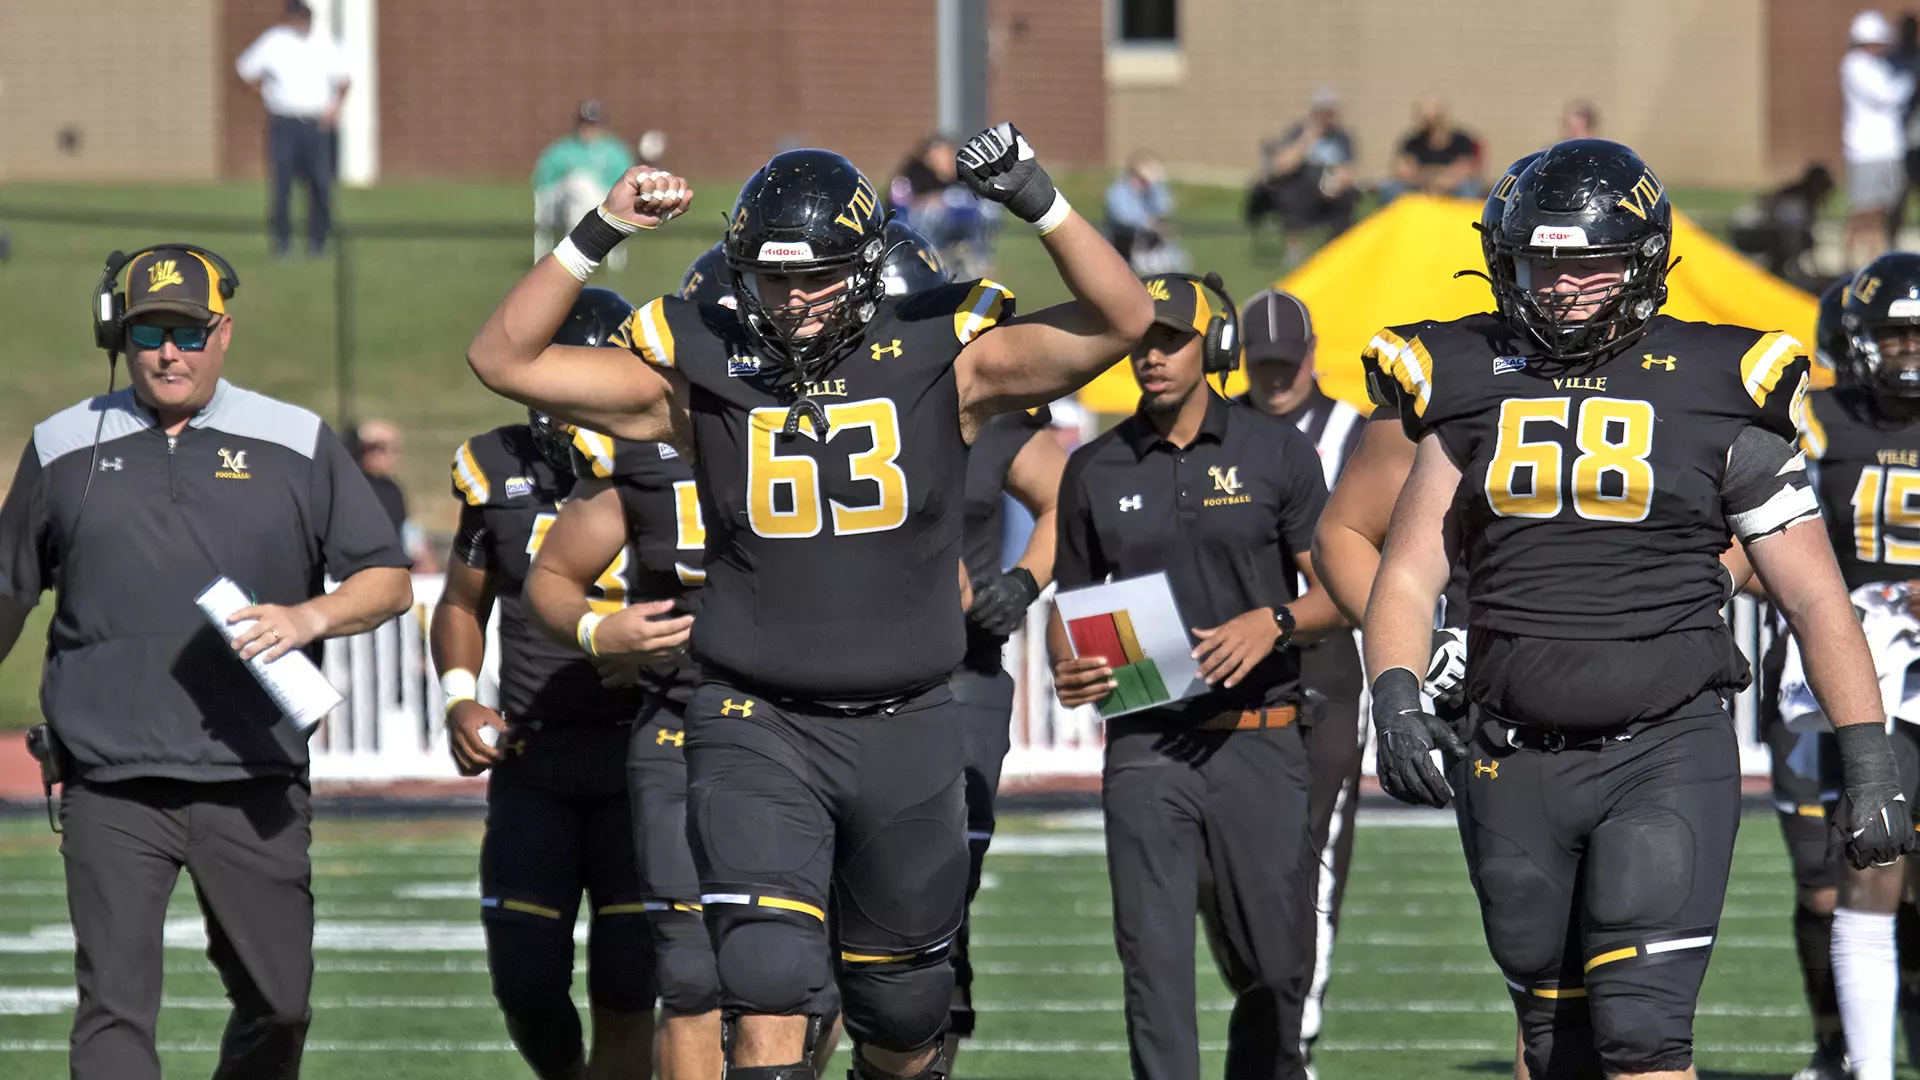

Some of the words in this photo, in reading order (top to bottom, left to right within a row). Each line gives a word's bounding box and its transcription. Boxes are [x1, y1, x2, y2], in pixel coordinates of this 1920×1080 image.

[147, 259, 185, 292] Ville
[1552, 376, 1607, 392] VILLE
[747, 397, 909, 539] 63
[1484, 396, 1655, 524] 68
[1876, 450, 1919, 467] VILLE
[215, 471, 251, 479] FOOTBALL
[1203, 495, 1251, 507] FOOTBALL
[1850, 464, 1920, 565] 15
